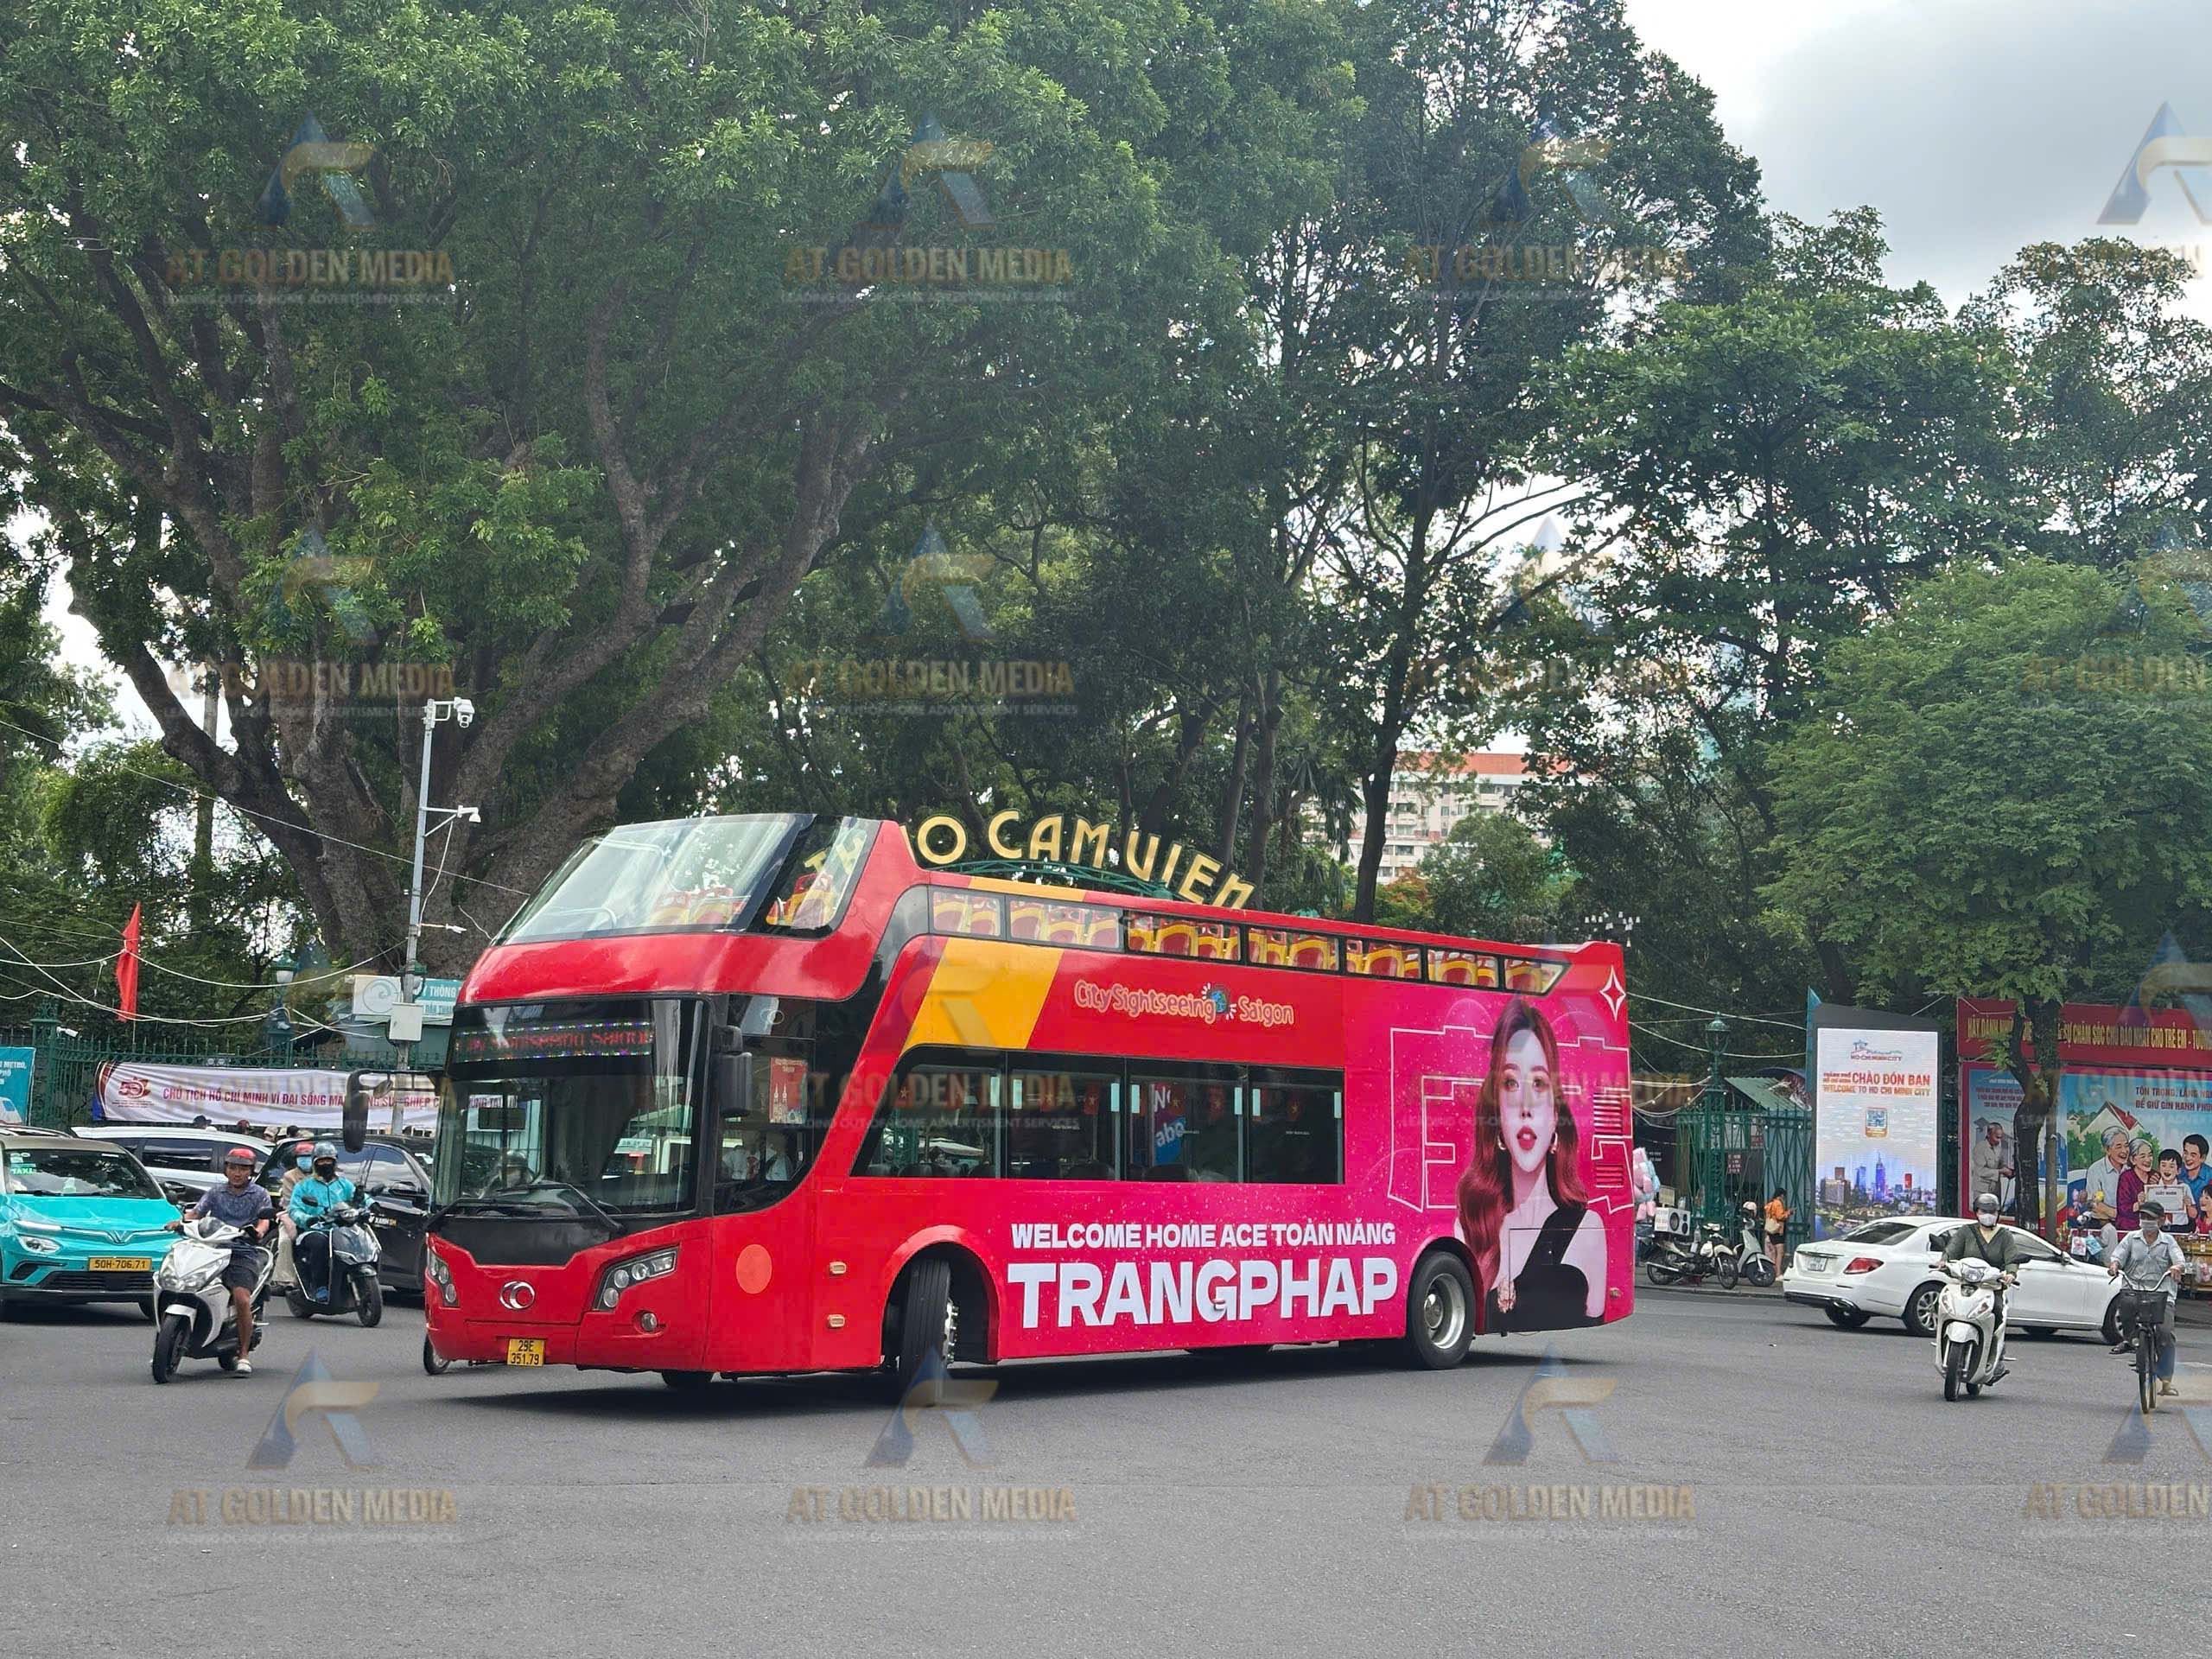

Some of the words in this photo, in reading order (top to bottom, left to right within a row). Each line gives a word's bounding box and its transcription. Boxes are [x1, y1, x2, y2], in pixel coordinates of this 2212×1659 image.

[1238, 995, 1294, 1027] Saigon
[2151, 1027, 2164, 1048] CHO
[2177, 1028, 2187, 1049] EM
[162, 1084, 182, 1100] CHỦ
[208, 1087, 221, 1102] HỒ
[243, 1092, 268, 1104] MINH
[283, 1093, 298, 1108] ĐẠI
[302, 1090, 326, 1106] SỐNG
[1822, 1084, 1856, 1093] WELCOME
[2135, 1085, 2150, 1096] TÔN
[1011, 1223, 1142, 1249] WELCOME
[1146, 1224, 1216, 1248] HOME
[1219, 1224, 1268, 1248] ACE
[1271, 1217, 1333, 1247] TOÀN
[1336, 1217, 1396, 1246] NĂNG
[94, 1259, 146, 1269] 50H-706.71
[1007, 1257, 1398, 1328] TRANGPHAP
[518, 1339, 535, 1351] 29E
[511, 1352, 540, 1365] 351.79
